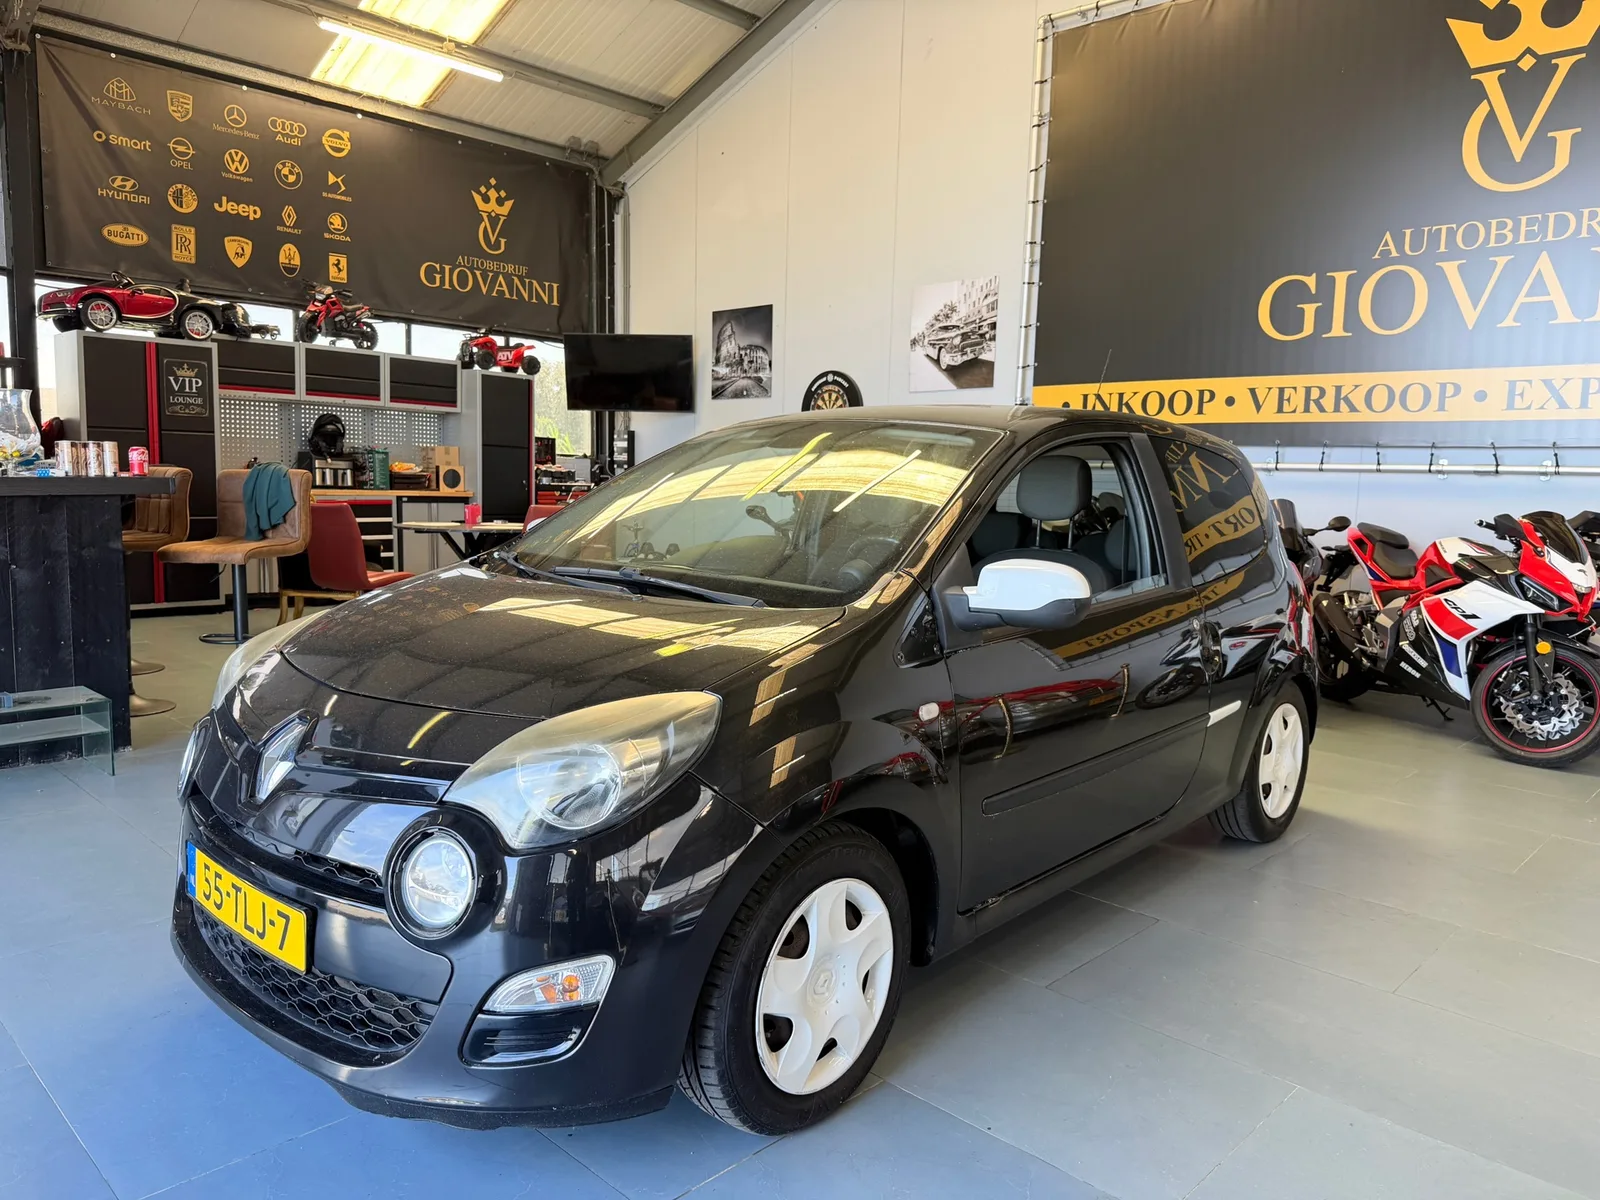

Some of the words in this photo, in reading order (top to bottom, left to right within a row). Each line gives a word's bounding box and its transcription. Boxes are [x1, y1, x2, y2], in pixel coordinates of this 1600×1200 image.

[91, 96, 151, 115] MAYBACH
[212, 123, 260, 140] Mercedes-Benz
[275, 134, 301, 146] Audi
[109, 134, 152, 151] smart
[325, 138, 348, 148] VOLVO
[170, 159, 193, 170] OPEL
[221, 171, 253, 183] Volkswagen
[97, 188, 150, 205] HYUNDAI
[213, 196, 261, 220] Jeep
[107, 229, 144, 242] BUGATTI
[276, 226, 303, 235] RENAULT
[455, 255, 529, 277] AUTOBEDRIJF
[419, 261, 560, 307] GIOVANNI
[1257, 246, 1600, 342] GIOVA
[497, 351, 514, 360] ATV
[168, 376, 203, 393] VIP
[169, 396, 204, 405] LOUNGE
[1080, 389, 1216, 416] INKOOP
[1247, 381, 1463, 415] VERKOOP
[202, 862, 291, 951] 55-TLJ-7
